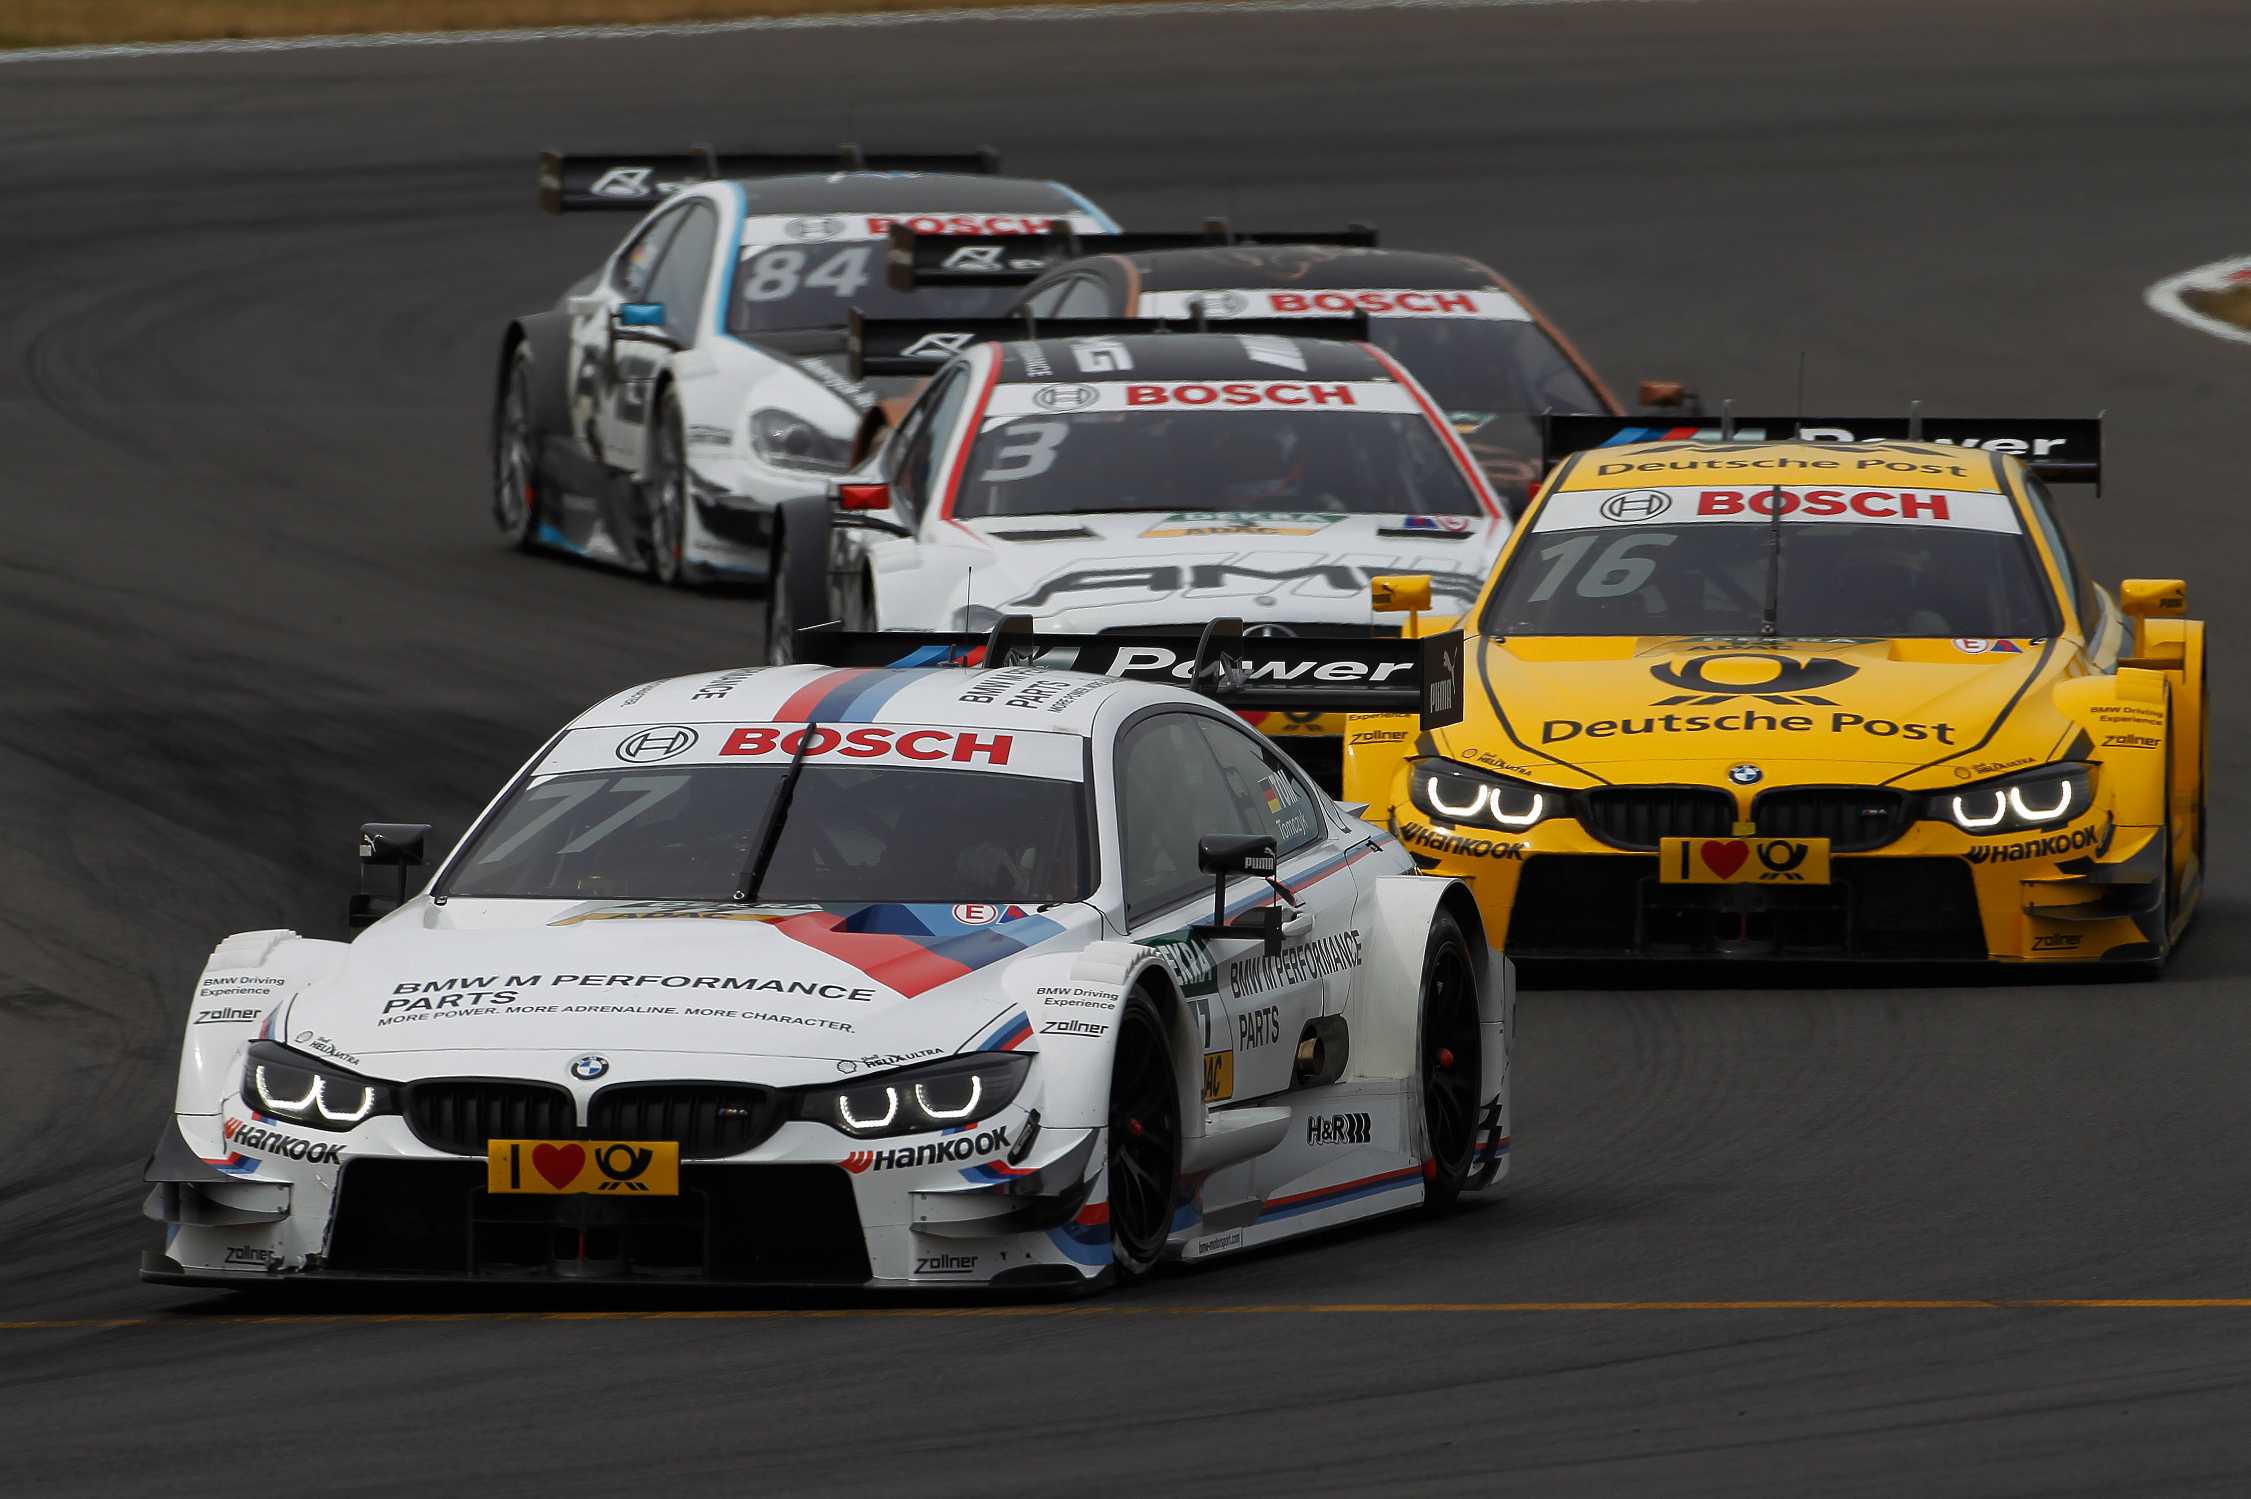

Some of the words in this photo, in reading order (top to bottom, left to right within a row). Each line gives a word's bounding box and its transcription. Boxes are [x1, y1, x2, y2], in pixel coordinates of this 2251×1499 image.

[744, 247, 872, 301] 84
[1266, 292, 1478, 313] BOSCH
[1126, 384, 1357, 406] BOSCH
[980, 421, 1069, 482] 3
[1598, 455, 1840, 477] Deutsche
[1855, 458, 1969, 478] Post
[1696, 490, 1950, 521] BOSCH
[1527, 533, 1679, 603] 16
[1004, 680, 1072, 710] PARTS
[1542, 711, 1813, 745] Deutsche
[1832, 712, 1955, 746] Post
[2100, 715, 2163, 727] Experience
[2123, 707, 2163, 719] Driving
[719, 728, 1012, 766] BOSCH
[477, 775, 692, 865] 77
[1681, 840, 1690, 880] I
[1990, 825, 2099, 864] Hankook
[965, 904, 985, 919] E
[1160, 938, 1216, 985] EKRA
[1231, 957, 1264, 998] BMW
[1263, 955, 1278, 990] M
[1274, 929, 1362, 987] PERFORMANCE
[200, 987, 271, 997] Experience
[204, 977, 239, 987] BMW
[239, 976, 285, 986] Driving
[393, 976, 499, 995] BMW
[505, 975, 543, 987] M
[551, 974, 876, 1002] PERFORMANCE
[1036, 987, 1070, 996] BMW
[1072, 988, 1120, 1001] Driving
[382, 990, 520, 1014] PARTS
[1043, 997, 1117, 1011] Experience
[377, 1012, 431, 1027] MORE
[433, 1006, 501, 1020] POWER.
[505, 1005, 557, 1014] MORE
[562, 1005, 680, 1015] ADRENALINE.
[684, 1007, 738, 1018] MORE
[740, 1011, 856, 1034] CHARACTER.
[1238, 1005, 1280, 1051] PARTS
[905, 1048, 944, 1060] ULTRA
[233, 1124, 346, 1164] Hankook
[1307, 1114, 1348, 1146] H&R
[873, 1126, 1011, 1171] Hankook
[511, 1144, 520, 1189] I
